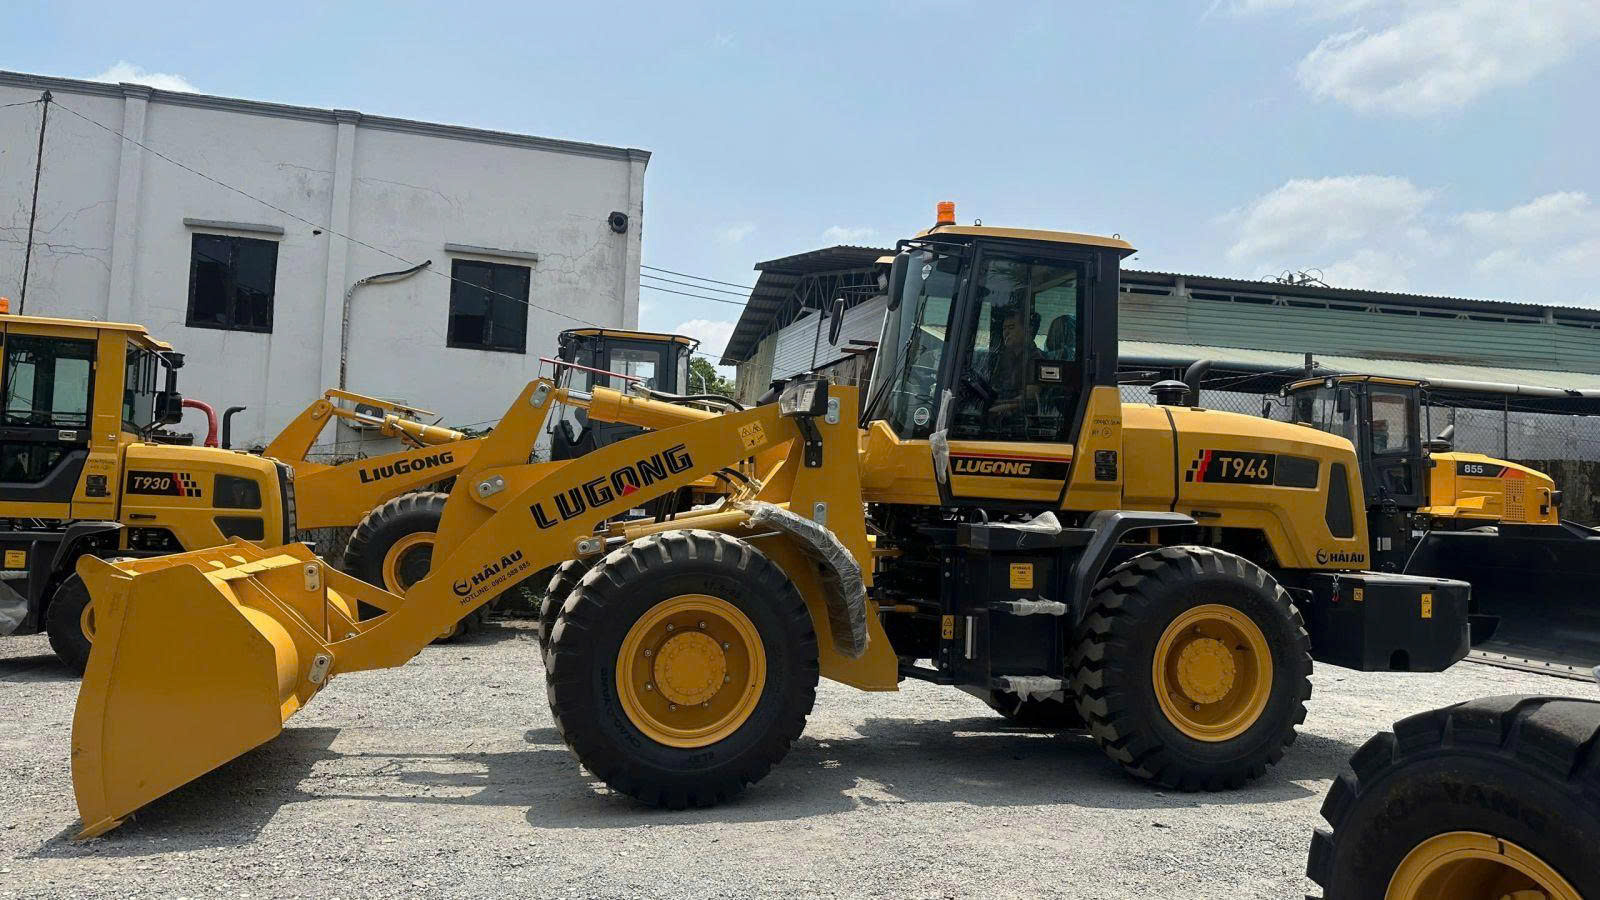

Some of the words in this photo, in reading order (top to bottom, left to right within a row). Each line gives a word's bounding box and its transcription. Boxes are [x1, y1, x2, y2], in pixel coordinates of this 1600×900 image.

[955, 459, 1032, 475] LUGONG
[1219, 457, 1268, 479] T946
[1464, 464, 1483, 474] 855
[133, 476, 170, 490] T930
[529, 443, 694, 530] LUGONG
[491, 574, 506, 587] 0902
